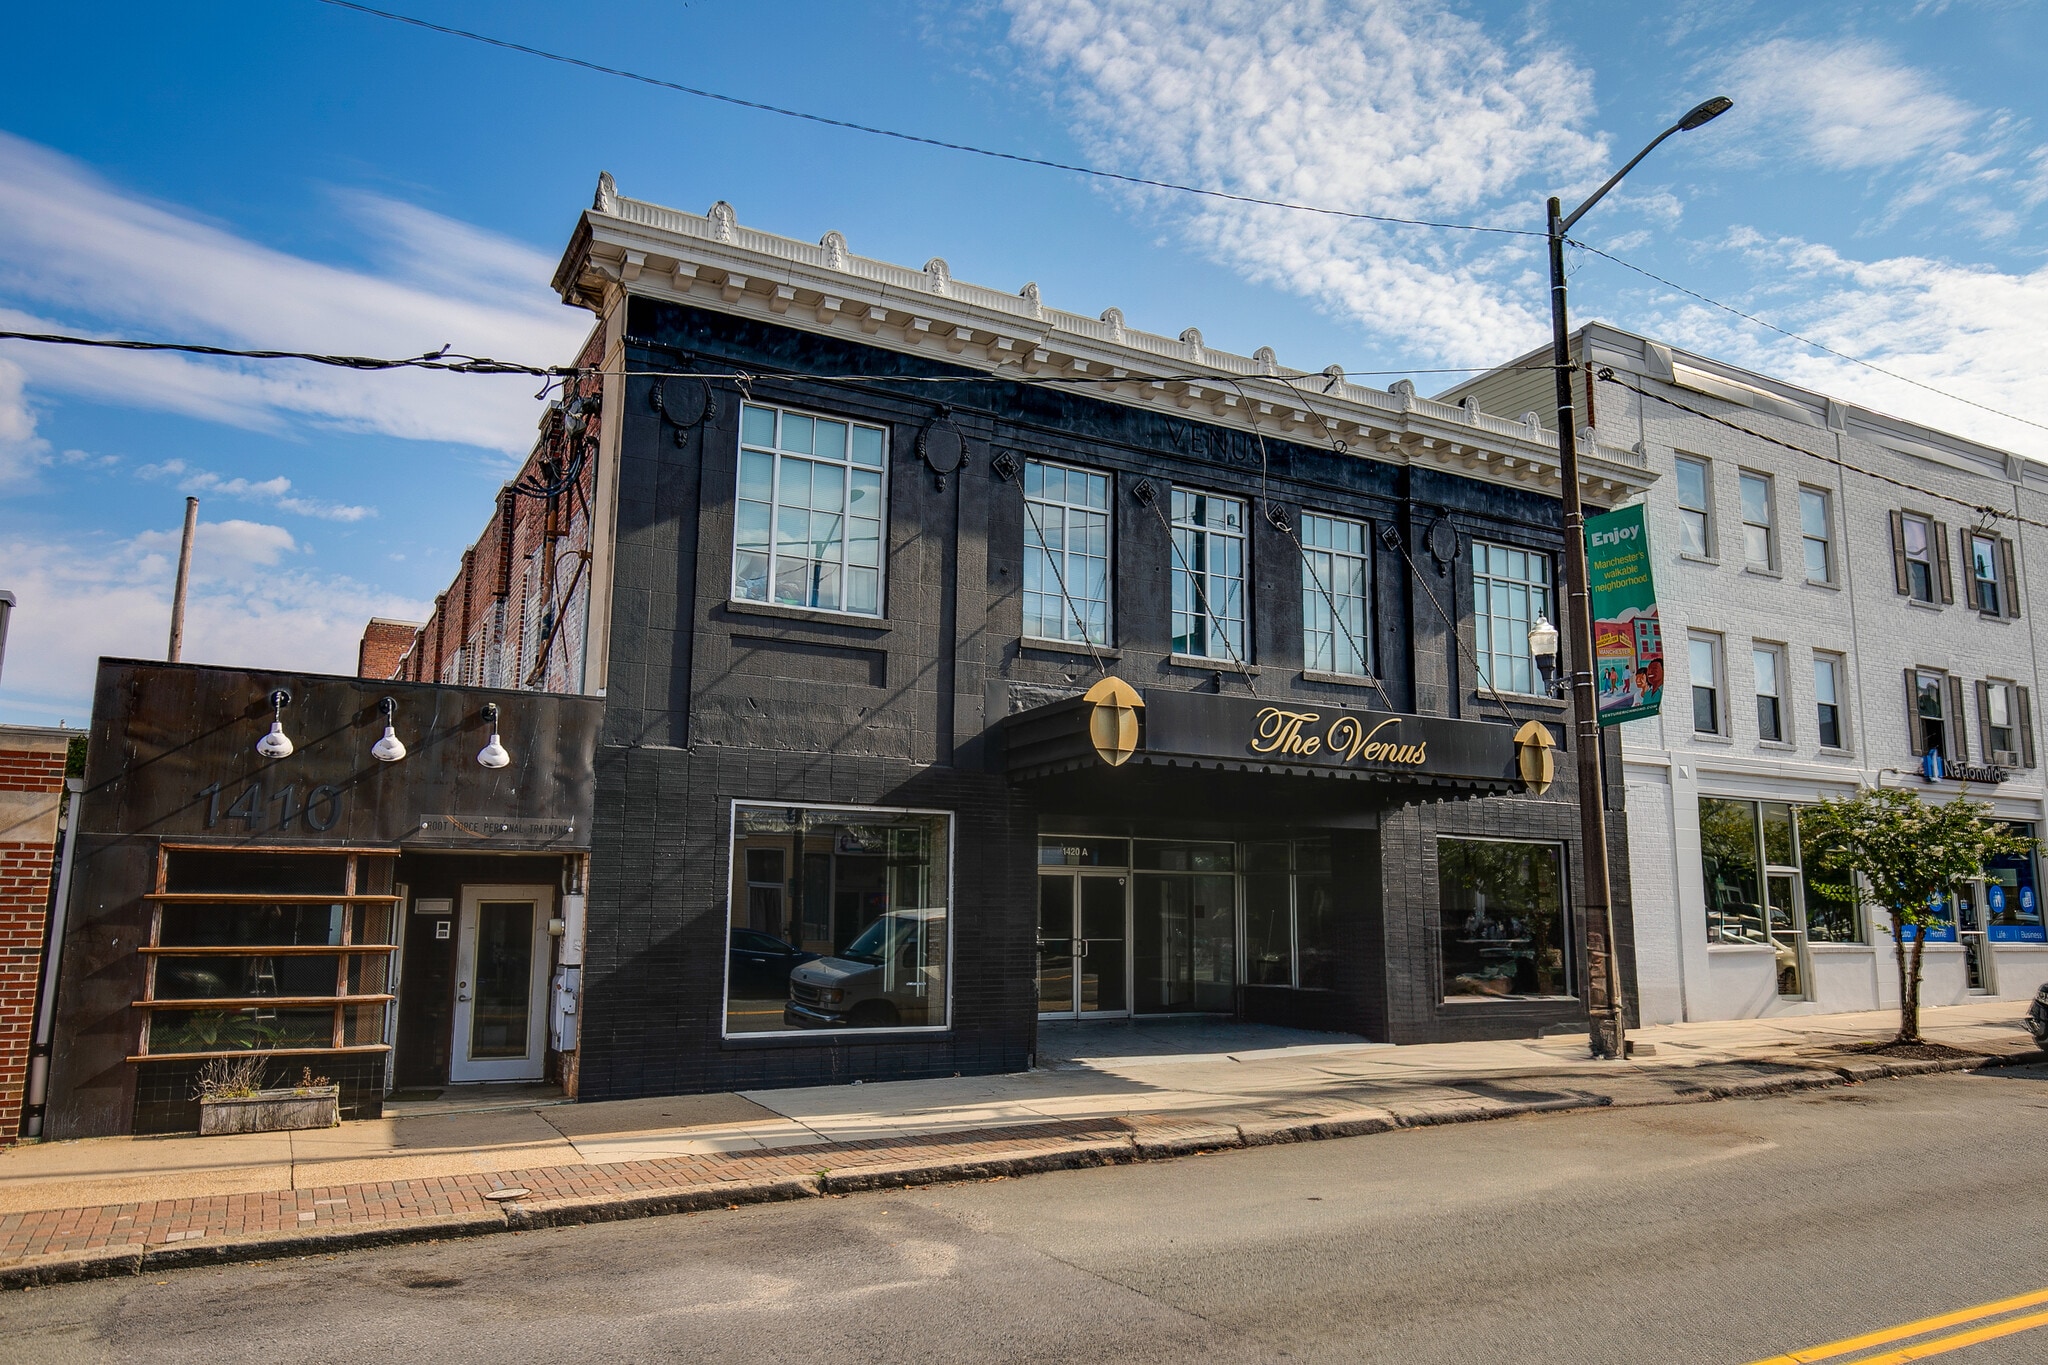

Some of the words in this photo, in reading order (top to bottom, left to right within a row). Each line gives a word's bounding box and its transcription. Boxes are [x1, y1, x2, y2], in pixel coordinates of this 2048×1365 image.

[1164, 418, 1264, 464] VENUS
[1591, 525, 1639, 547] Enjoy
[1594, 551, 1645, 570] Manchester's
[1604, 565, 1638, 579] walkable
[1252, 707, 1320, 755] The
[1327, 716, 1427, 765] Venus
[1943, 759, 2010, 782] Nationwide
[196, 782, 342, 832] 1410
[427, 821, 448, 831] ROOT
[452, 822, 479, 832] FORCE
[484, 823, 523, 834] PERSONAL
[1063, 847, 1080, 857] 1420
[1081, 848, 1088, 857] A
[1930, 930, 1947, 938] Home
[1996, 931, 2006, 939] Life
[2020, 931, 2043, 940] Business
